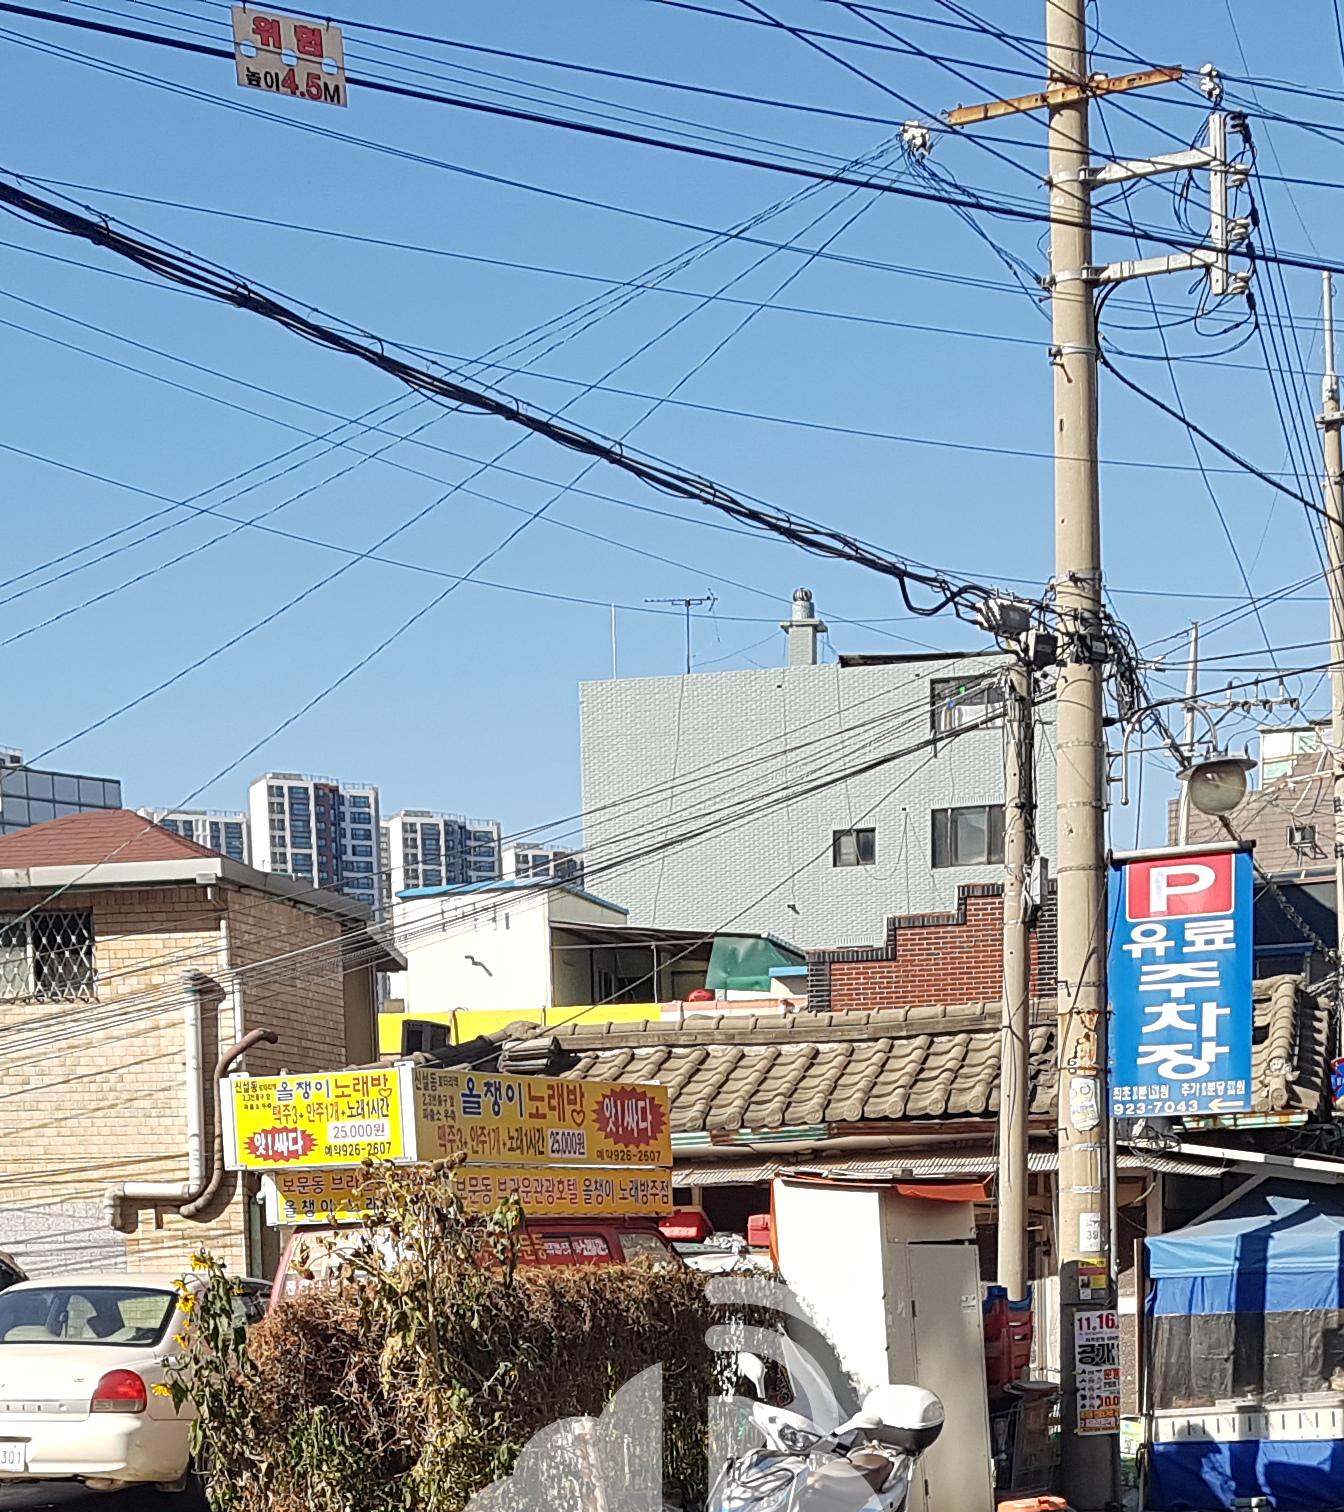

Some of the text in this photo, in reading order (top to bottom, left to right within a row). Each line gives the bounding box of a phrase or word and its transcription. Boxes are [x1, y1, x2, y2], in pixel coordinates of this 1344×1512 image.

[252, 15, 324, 58] 위험
[1149, 864, 1216, 912] P
[1122, 919, 1236, 958] 유료
[1137, 961, 1231, 1080] 주차장
[277, 1074, 393, 1101] 올챙이 노래방
[461, 1077, 586, 1127] 올챙이 노래방
[1113, 1100, 1198, 1115] 923-7043
[283, 1175, 325, 1194] 보문동
[456, 1176, 492, 1205] 보문동
[582, 1178, 615, 1205] 올챙이
[619, 1179, 669, 1205] 노래방주점
